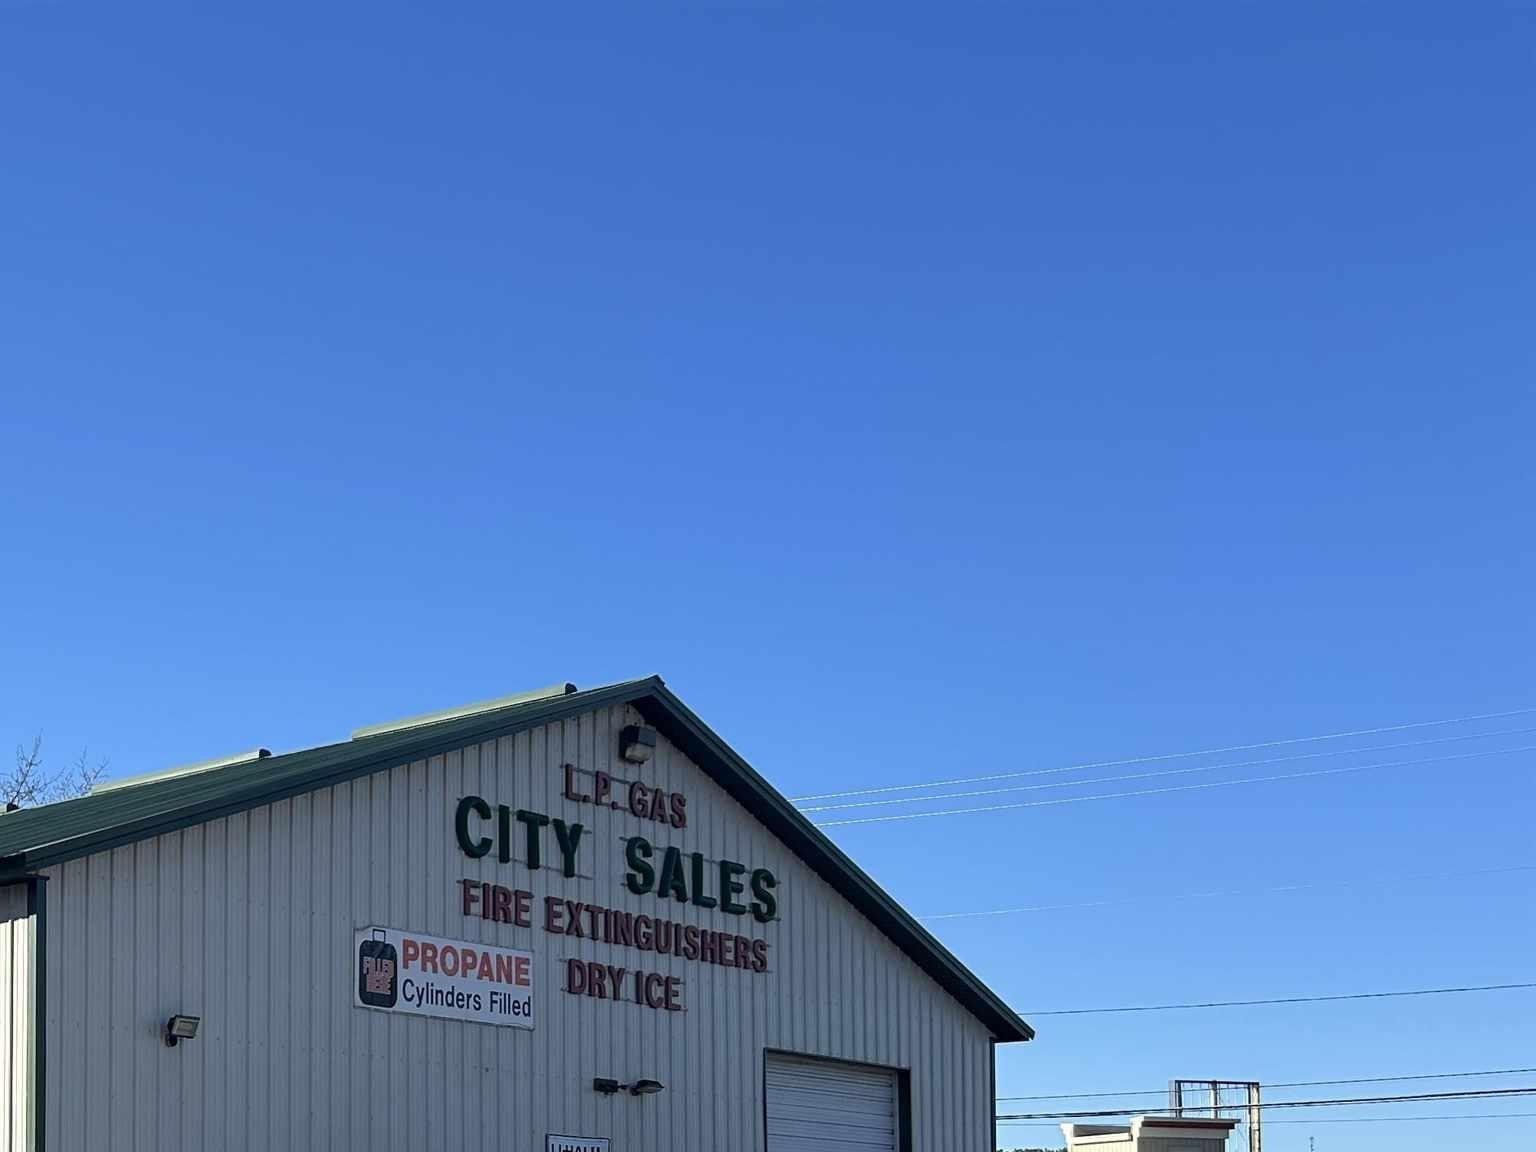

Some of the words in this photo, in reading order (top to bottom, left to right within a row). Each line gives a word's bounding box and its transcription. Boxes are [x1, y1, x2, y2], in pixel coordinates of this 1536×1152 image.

[565, 764, 619, 810] L.P.
[629, 780, 687, 829] GAS
[456, 795, 583, 878] CITY
[625, 836, 777, 922] SALES
[463, 878, 533, 928] FIRE
[544, 896, 768, 972] EXTINGUISHERS
[402, 939, 531, 987] PROPANE
[568, 958, 626, 1001] DRY
[635, 970, 683, 1011] ICE
[402, 978, 482, 1012] Cylinders
[490, 990, 531, 1018] Filled
